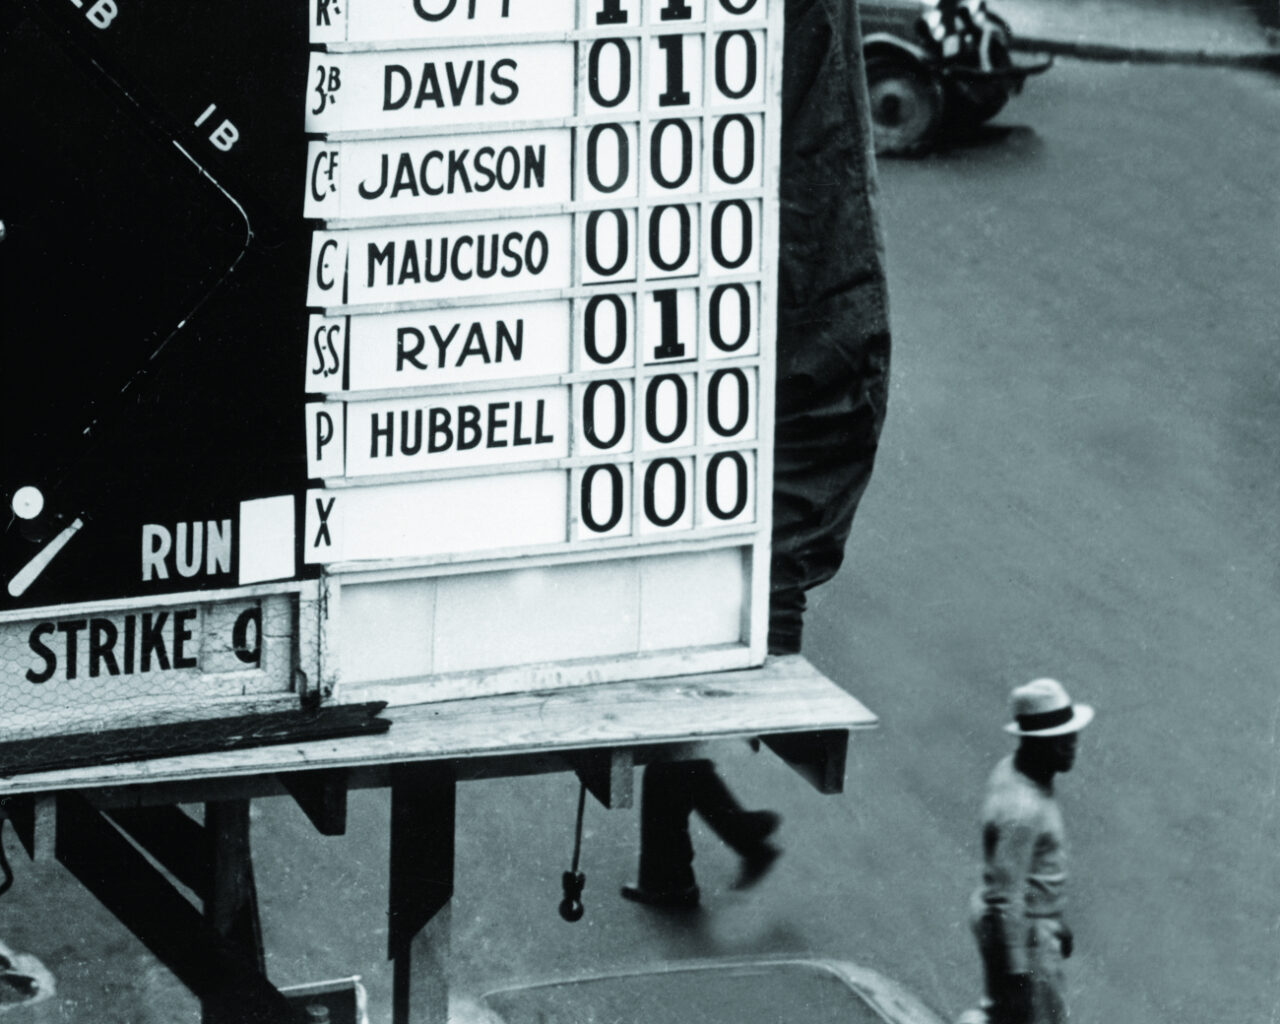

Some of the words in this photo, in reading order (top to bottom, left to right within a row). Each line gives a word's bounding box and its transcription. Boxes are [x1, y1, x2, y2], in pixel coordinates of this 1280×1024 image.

[383, 59, 518, 110] DAVIS
[589, 38, 630, 107] 0
[658, 34, 689, 106] 1
[716, 30, 756, 99] 0
[195, 104, 239, 151] 1B
[359, 145, 545, 200] JACKSON
[587, 123, 628, 192] 0
[651, 118, 692, 189] 0
[713, 114, 754, 184] 0
[317, 239, 338, 290] C
[368, 231, 548, 287] MAUCUSO
[586, 209, 628, 276] 0
[649, 204, 690, 271] 0
[712, 199, 752, 268] 0
[397, 319, 523, 371] RYAN
[585, 294, 626, 364] 0
[653, 289, 684, 359] 1
[710, 283, 750, 351] 0
[316, 411, 333, 460] P
[371, 400, 553, 458] HUBBELL
[583, 379, 625, 449] 0
[646, 374, 687, 443] 0
[708, 368, 748, 436] 0
[314, 497, 335, 547] X
[581, 464, 623, 532] 0
[644, 457, 685, 526] 0
[707, 451, 747, 520] 0
[142, 520, 231, 580] RUN
[26, 610, 197, 683] STRIKE
